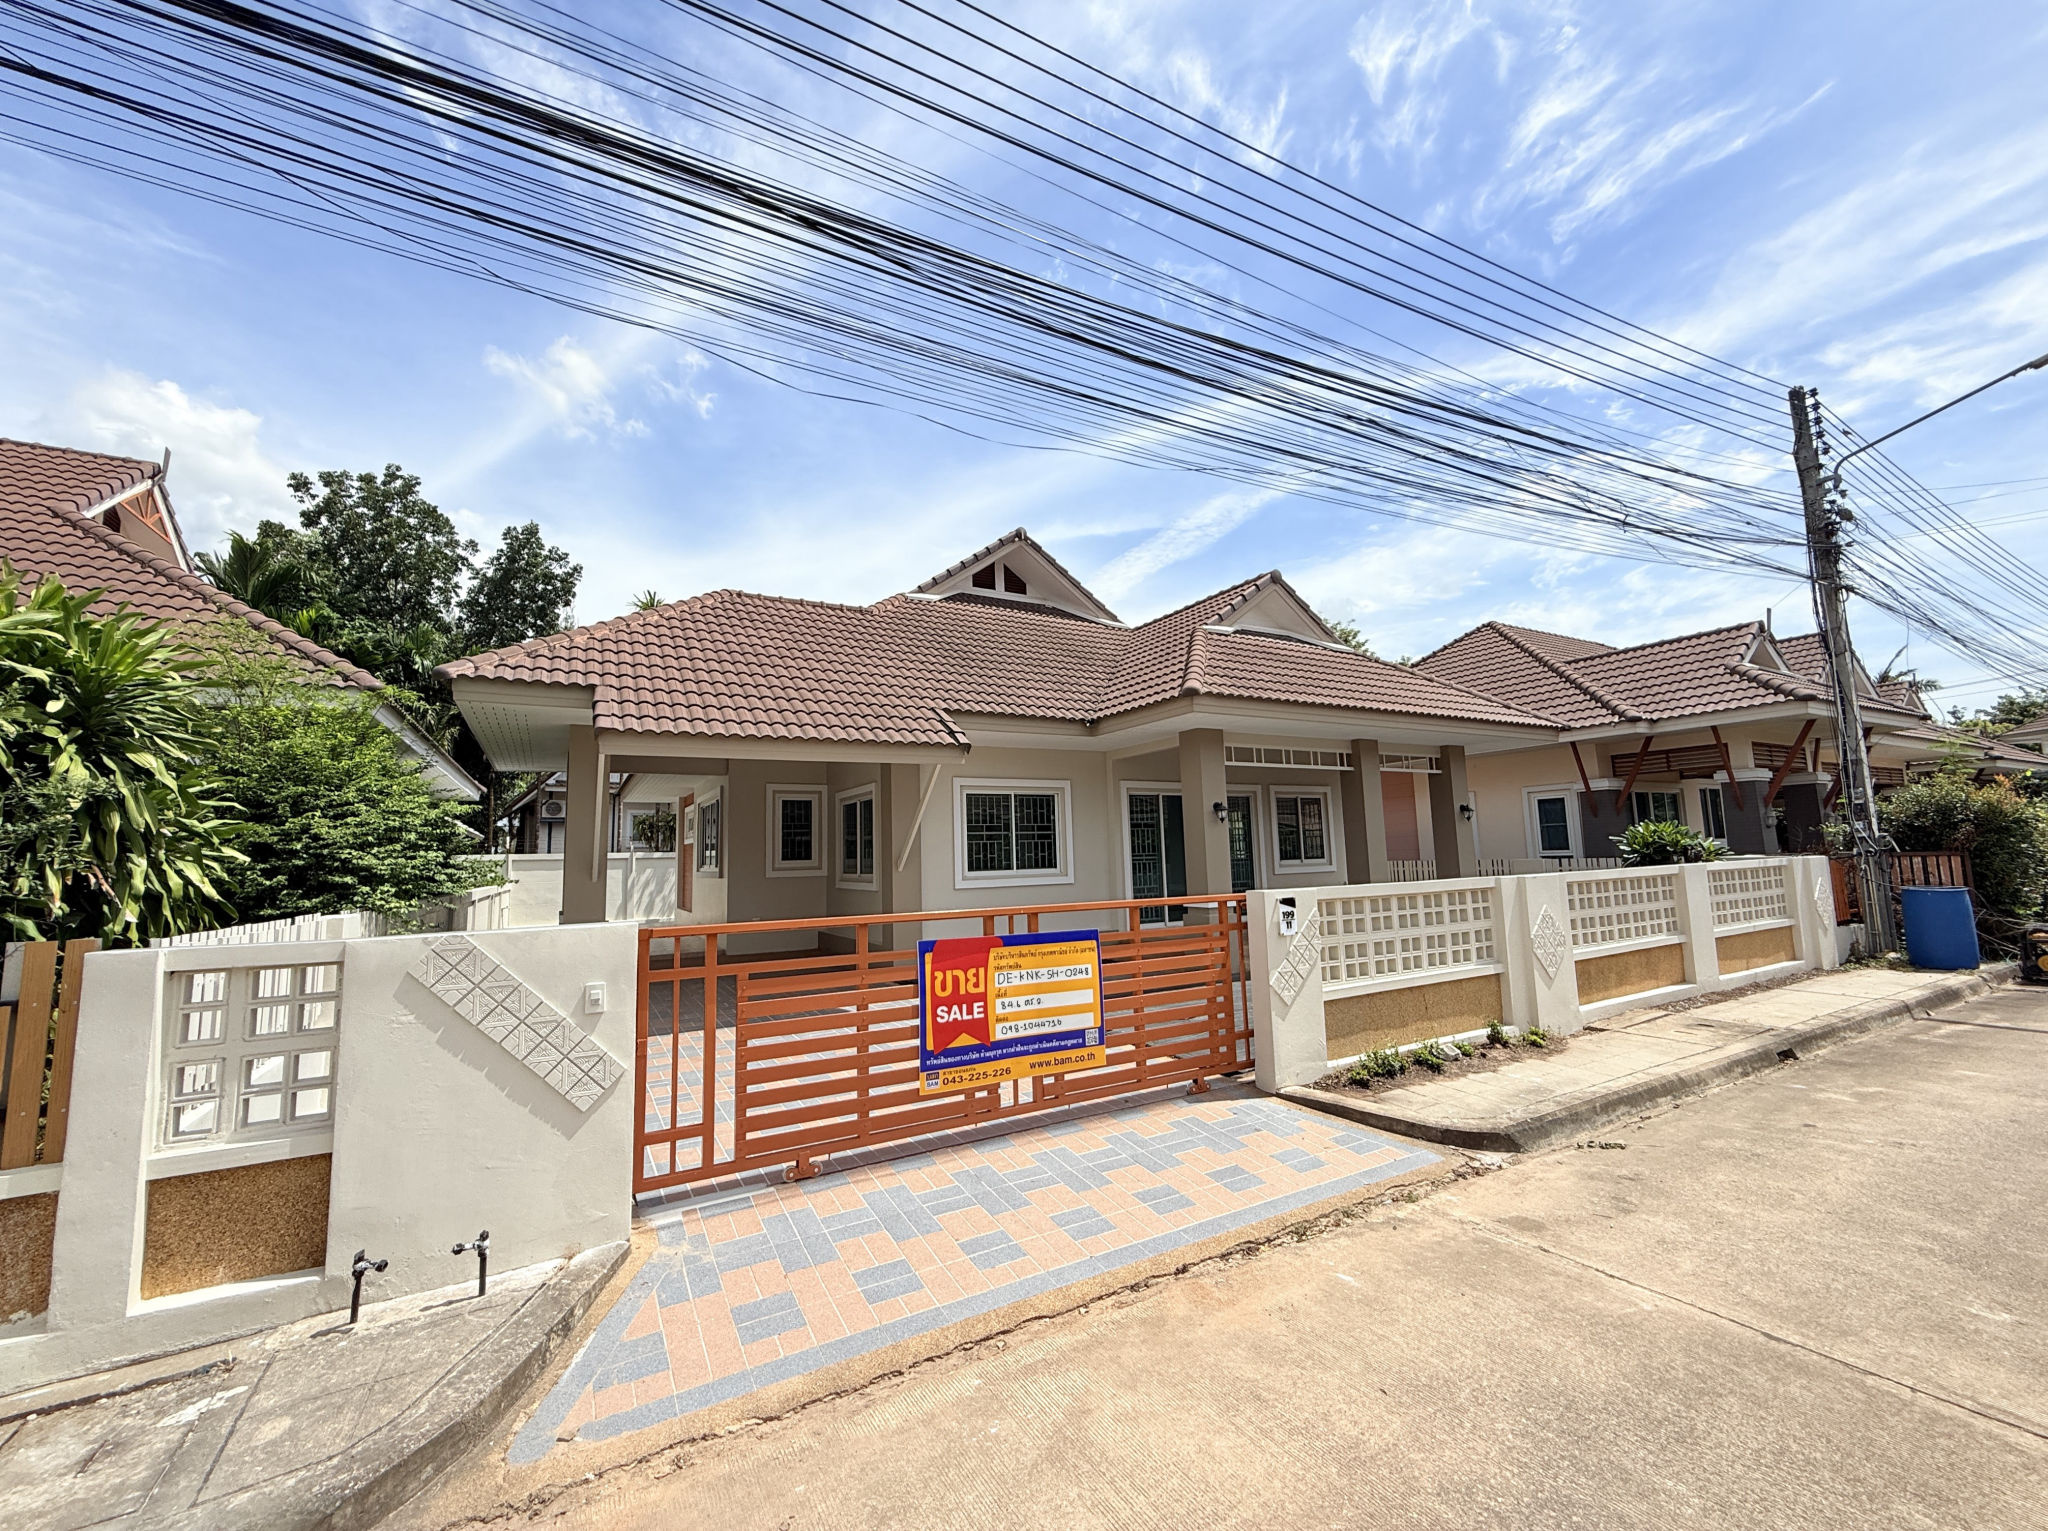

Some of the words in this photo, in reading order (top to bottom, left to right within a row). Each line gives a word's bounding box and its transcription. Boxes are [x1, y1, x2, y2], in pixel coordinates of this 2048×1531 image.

[1282, 910, 1295, 919] 199
[1286, 921, 1292, 929] 11
[934, 967, 985, 998] ขาย
[936, 1002, 985, 1023] SALE
[1029, 1052, 1096, 1070] www.bam.co.th
[942, 1067, 1012, 1086] 043-225-226
